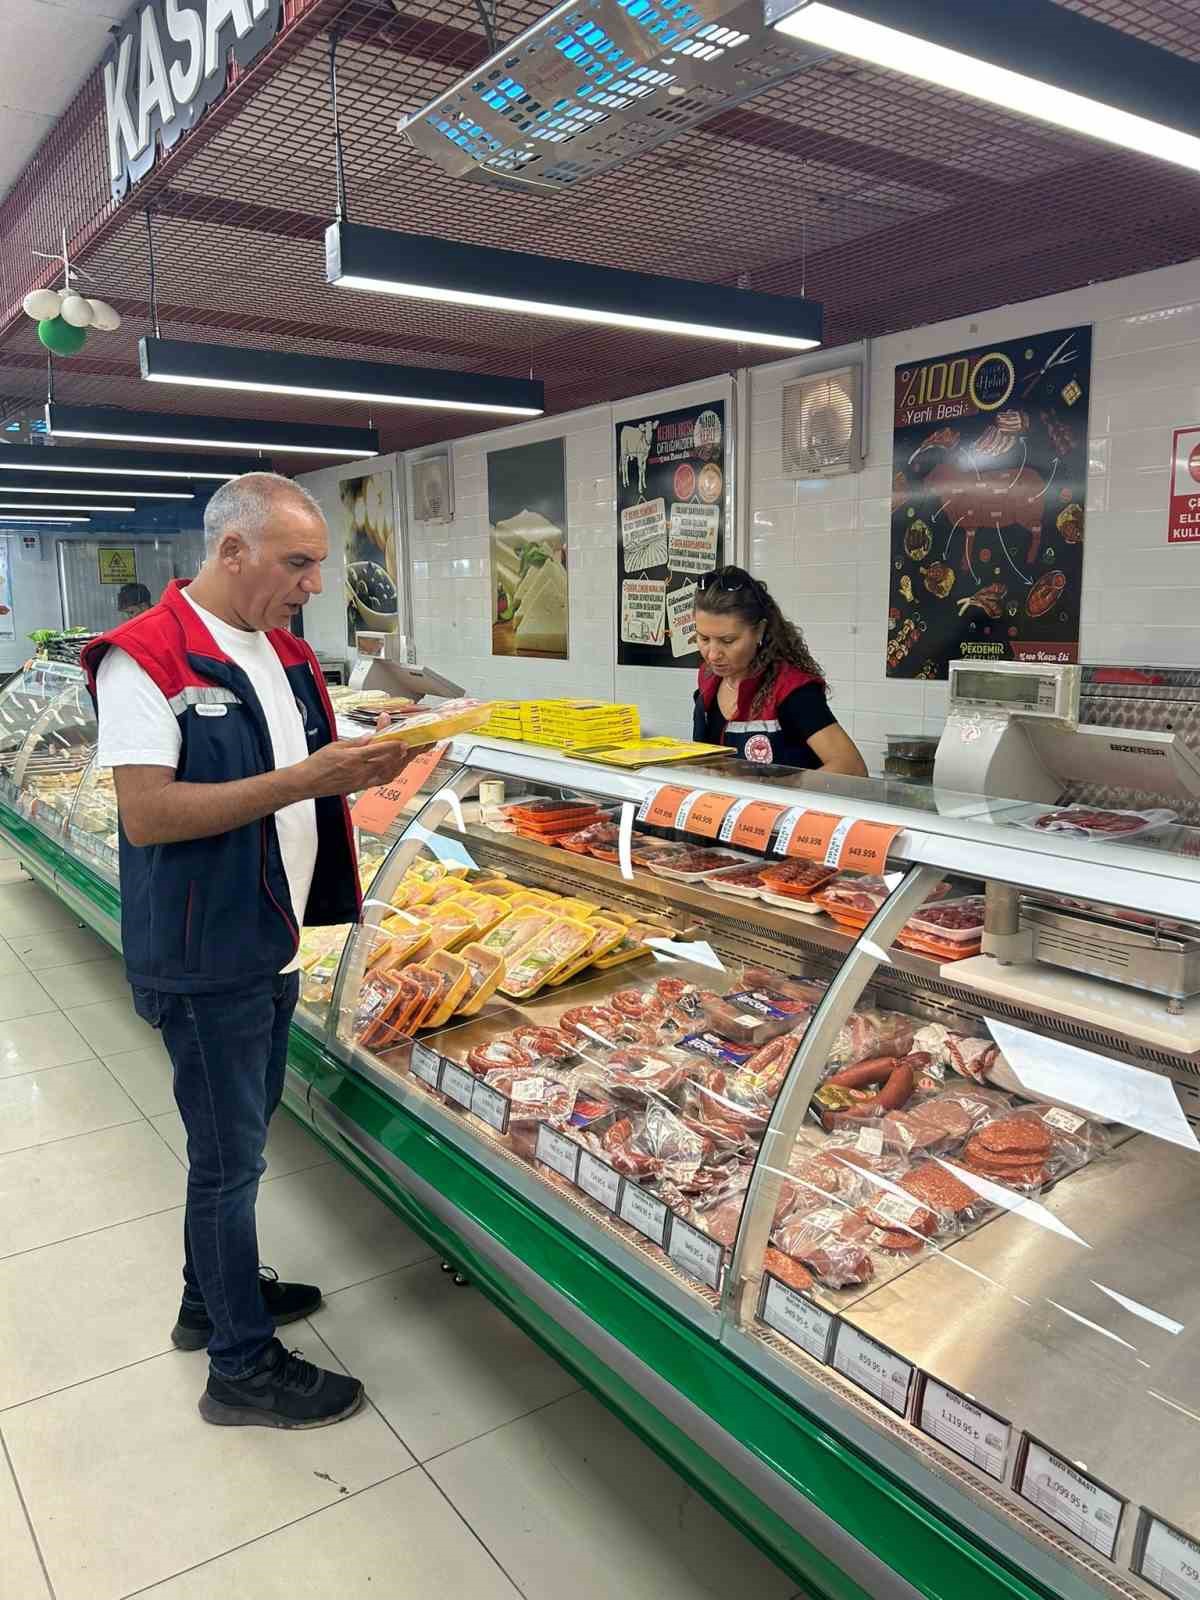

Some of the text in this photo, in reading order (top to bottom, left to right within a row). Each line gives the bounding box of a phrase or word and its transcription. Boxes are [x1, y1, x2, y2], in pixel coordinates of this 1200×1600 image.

[103, 0, 270, 182] KASA
[901, 358, 969, 408] %100
[906, 400, 964, 425] Yerli Besi
